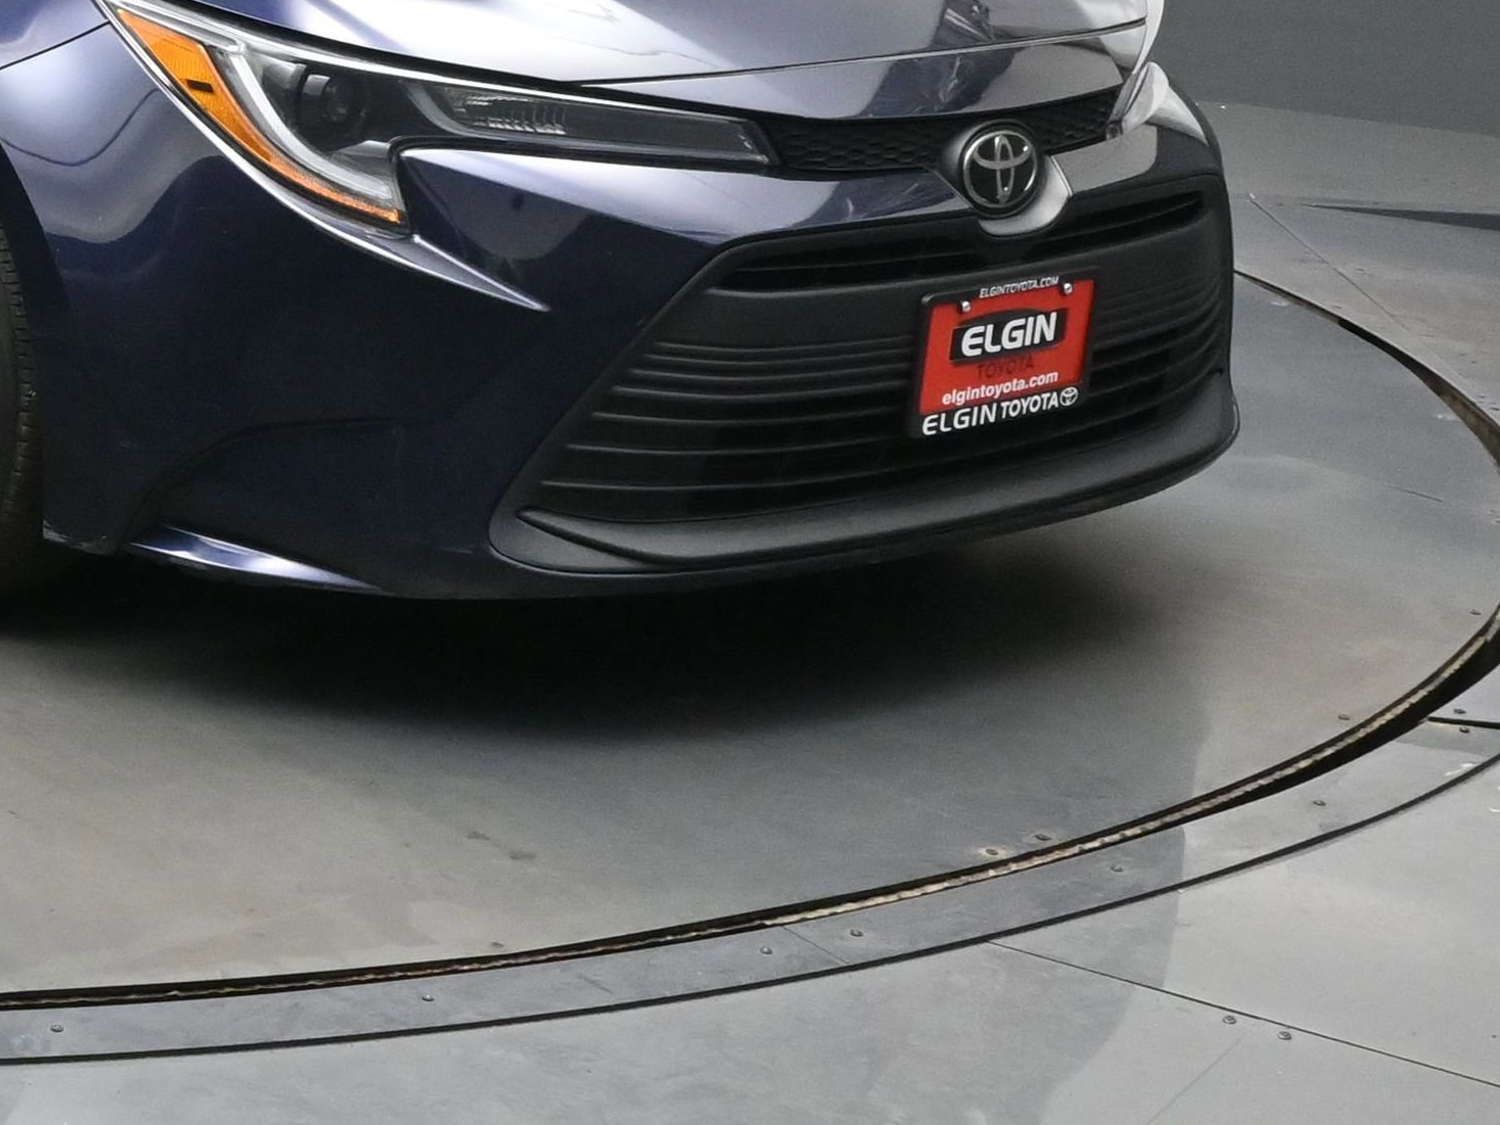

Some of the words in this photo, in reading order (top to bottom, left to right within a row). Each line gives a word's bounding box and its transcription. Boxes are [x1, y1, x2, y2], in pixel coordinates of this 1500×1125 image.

[979, 277, 1059, 298] ELGINTOYOTA.COM
[961, 312, 1058, 357] ELGIN
[978, 355, 1034, 379] TOYOTA
[942, 372, 1058, 406] elgintoyota.com
[922, 403, 997, 435] ELGIN
[1000, 392, 1059, 420] TOYOTA
